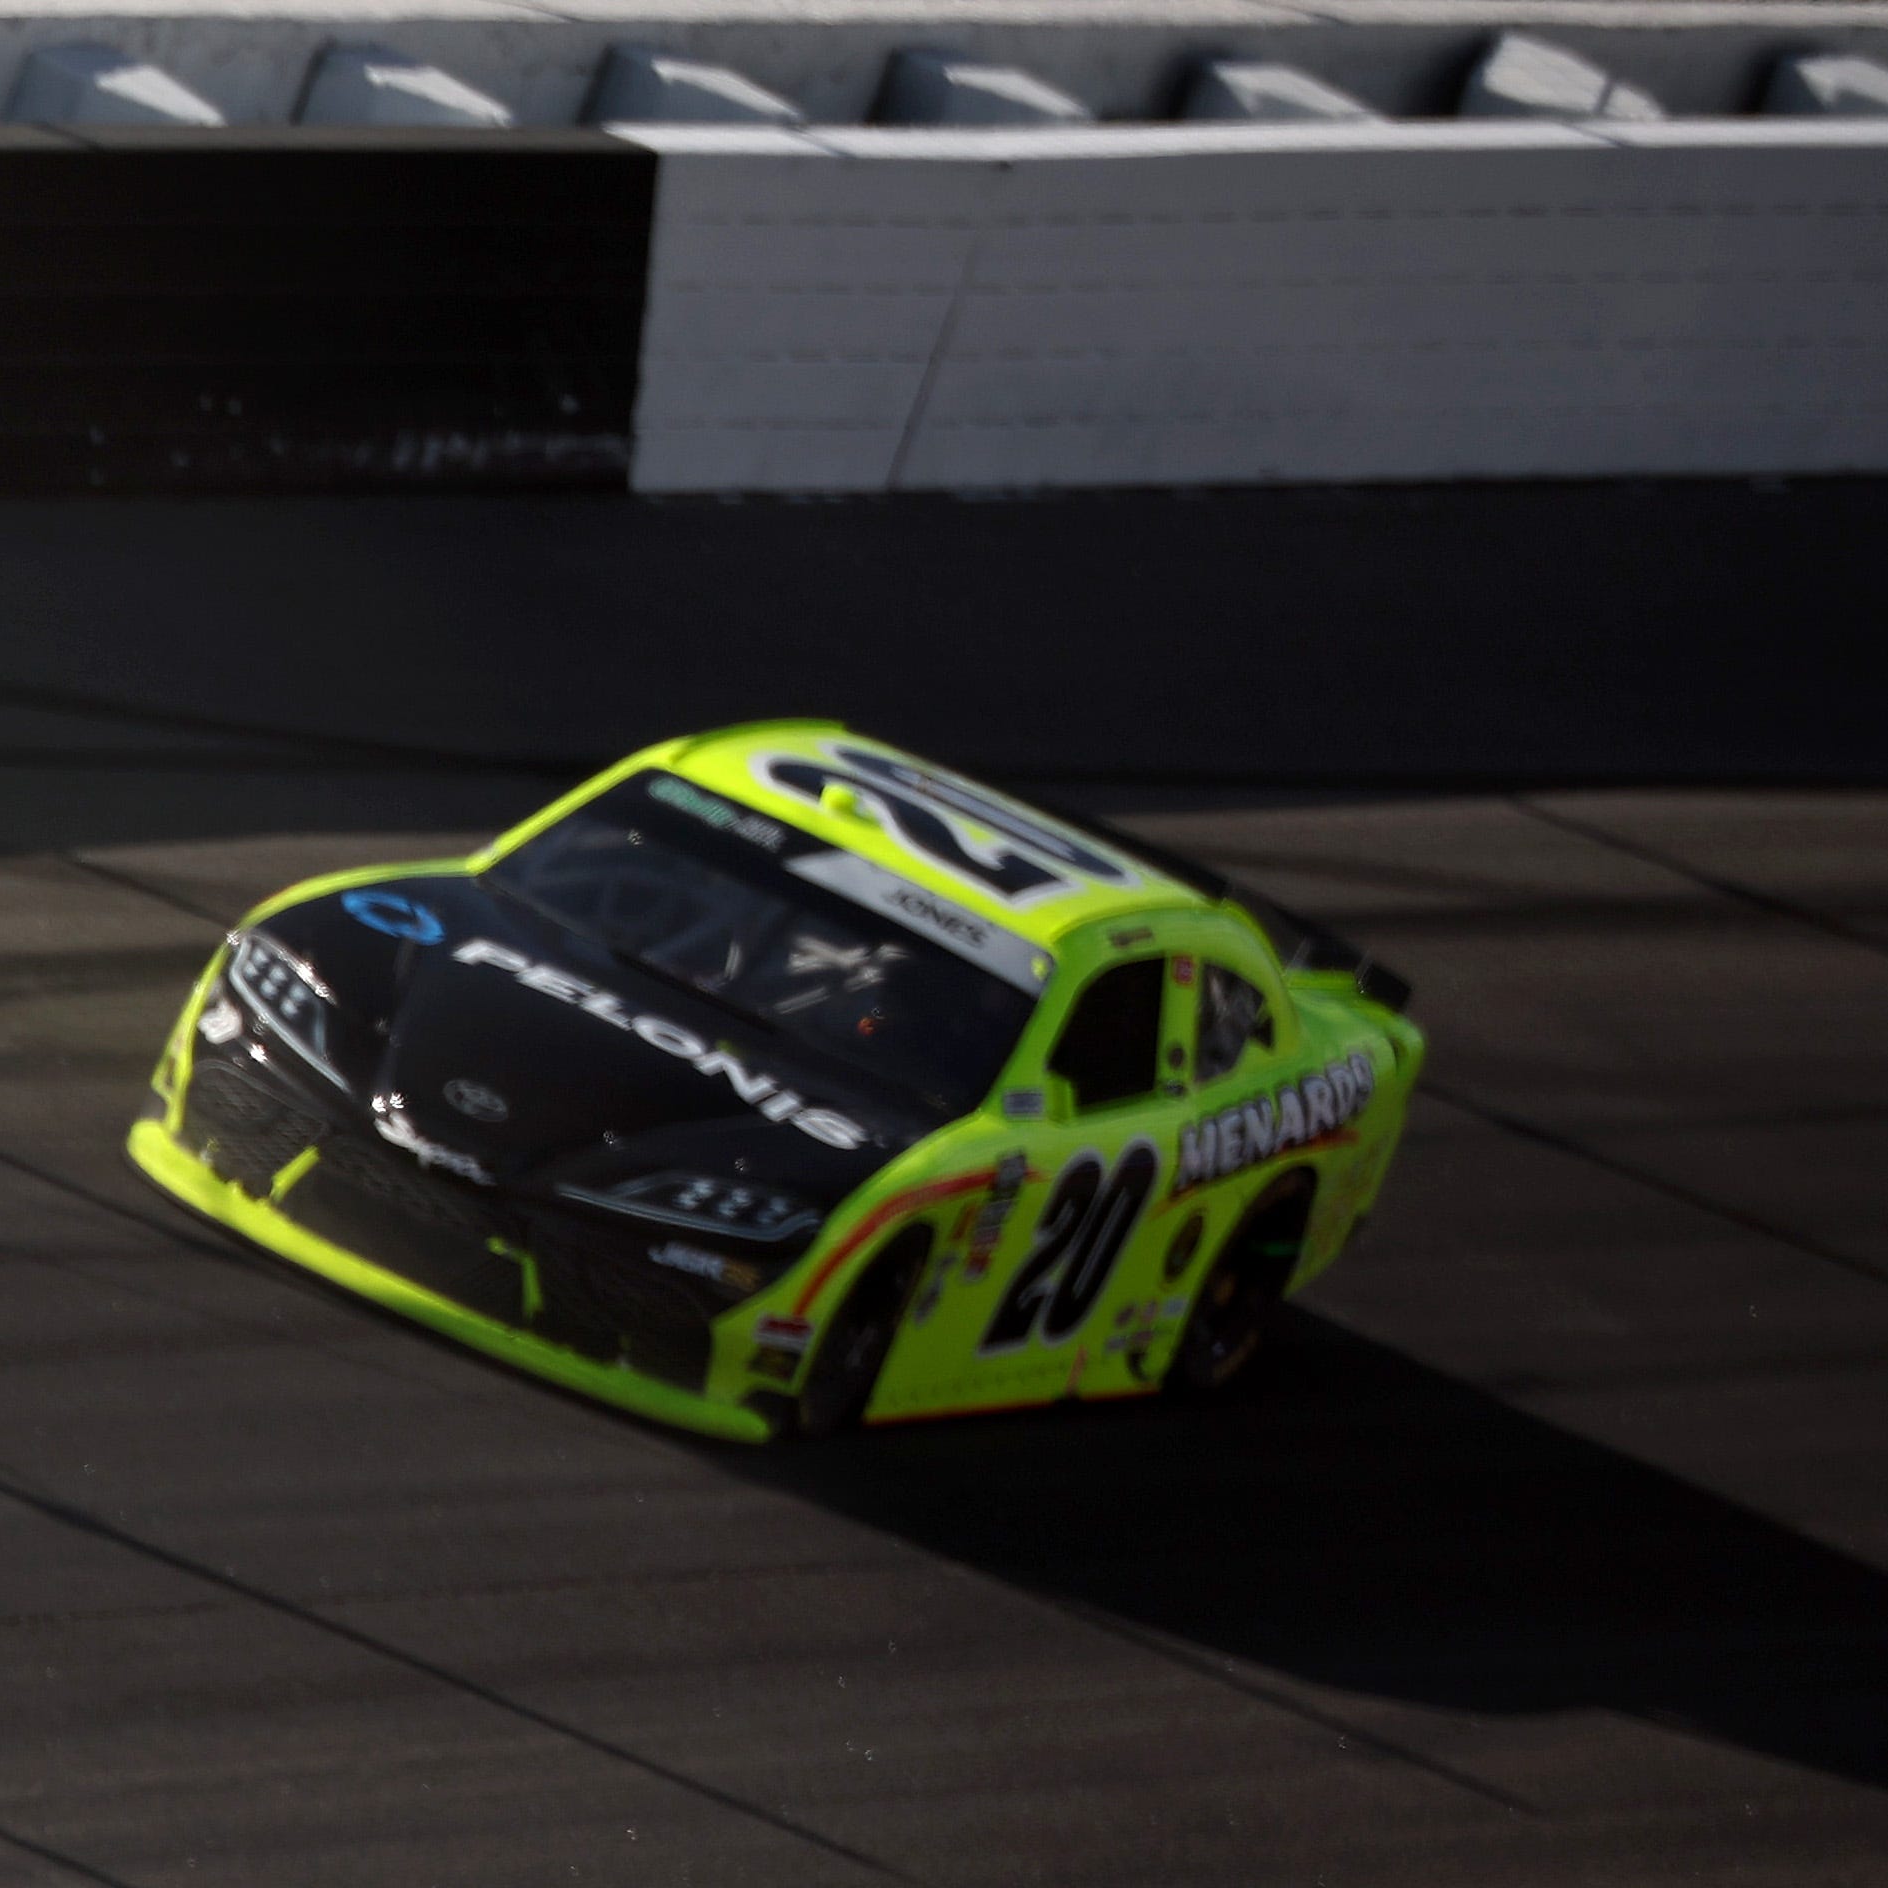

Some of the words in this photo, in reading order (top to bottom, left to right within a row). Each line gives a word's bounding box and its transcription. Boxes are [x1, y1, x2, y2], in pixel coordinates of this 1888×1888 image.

[893, 888, 991, 950] JONES
[451, 936, 871, 1152] PELONIS
[1171, 1052, 1376, 1190] MENARDS
[976, 1137, 1161, 1356] 20
